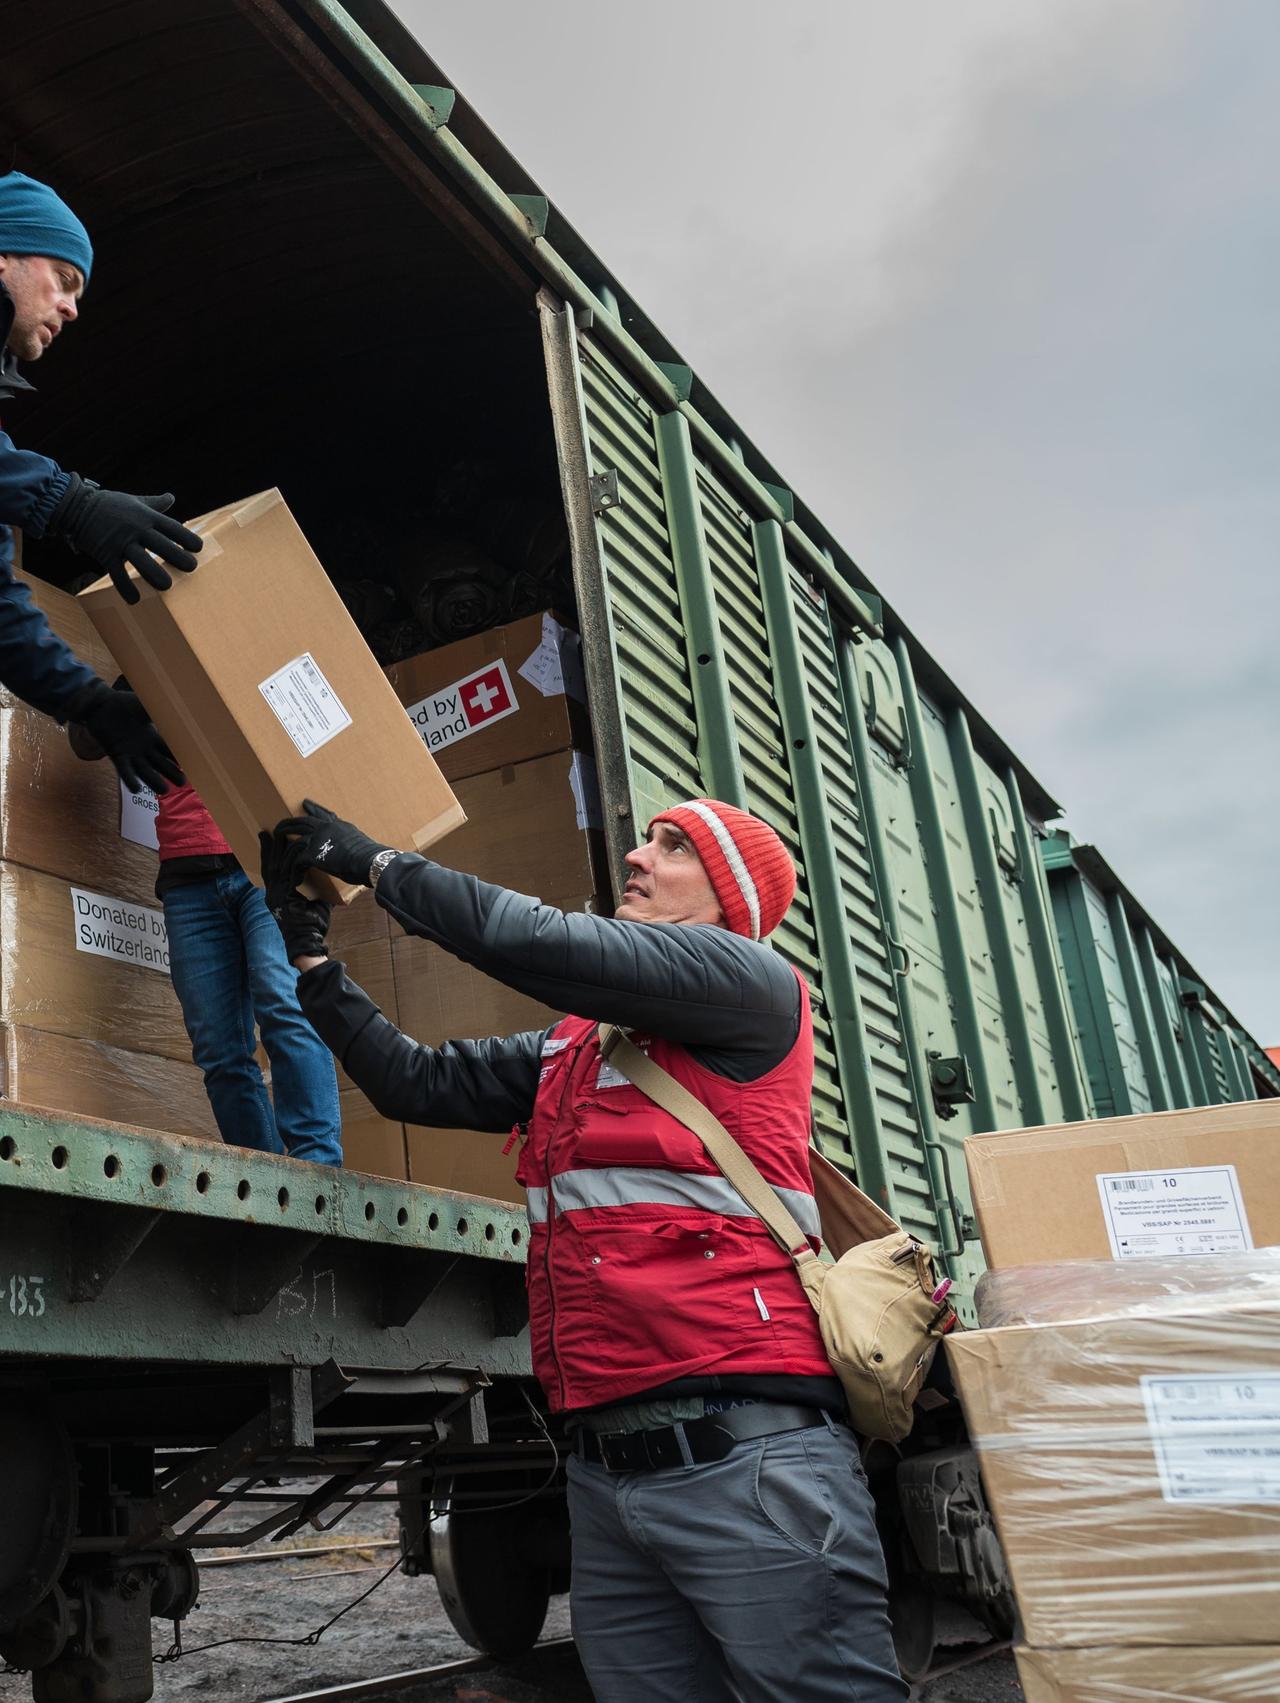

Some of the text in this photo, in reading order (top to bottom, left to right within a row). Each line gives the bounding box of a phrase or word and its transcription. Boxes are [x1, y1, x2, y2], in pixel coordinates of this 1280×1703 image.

[433, 694, 457, 717] by
[76, 895, 168, 943] Donated by
[1162, 1178, 1177, 1188] 10
[1234, 1385, 1256, 1400] 10
